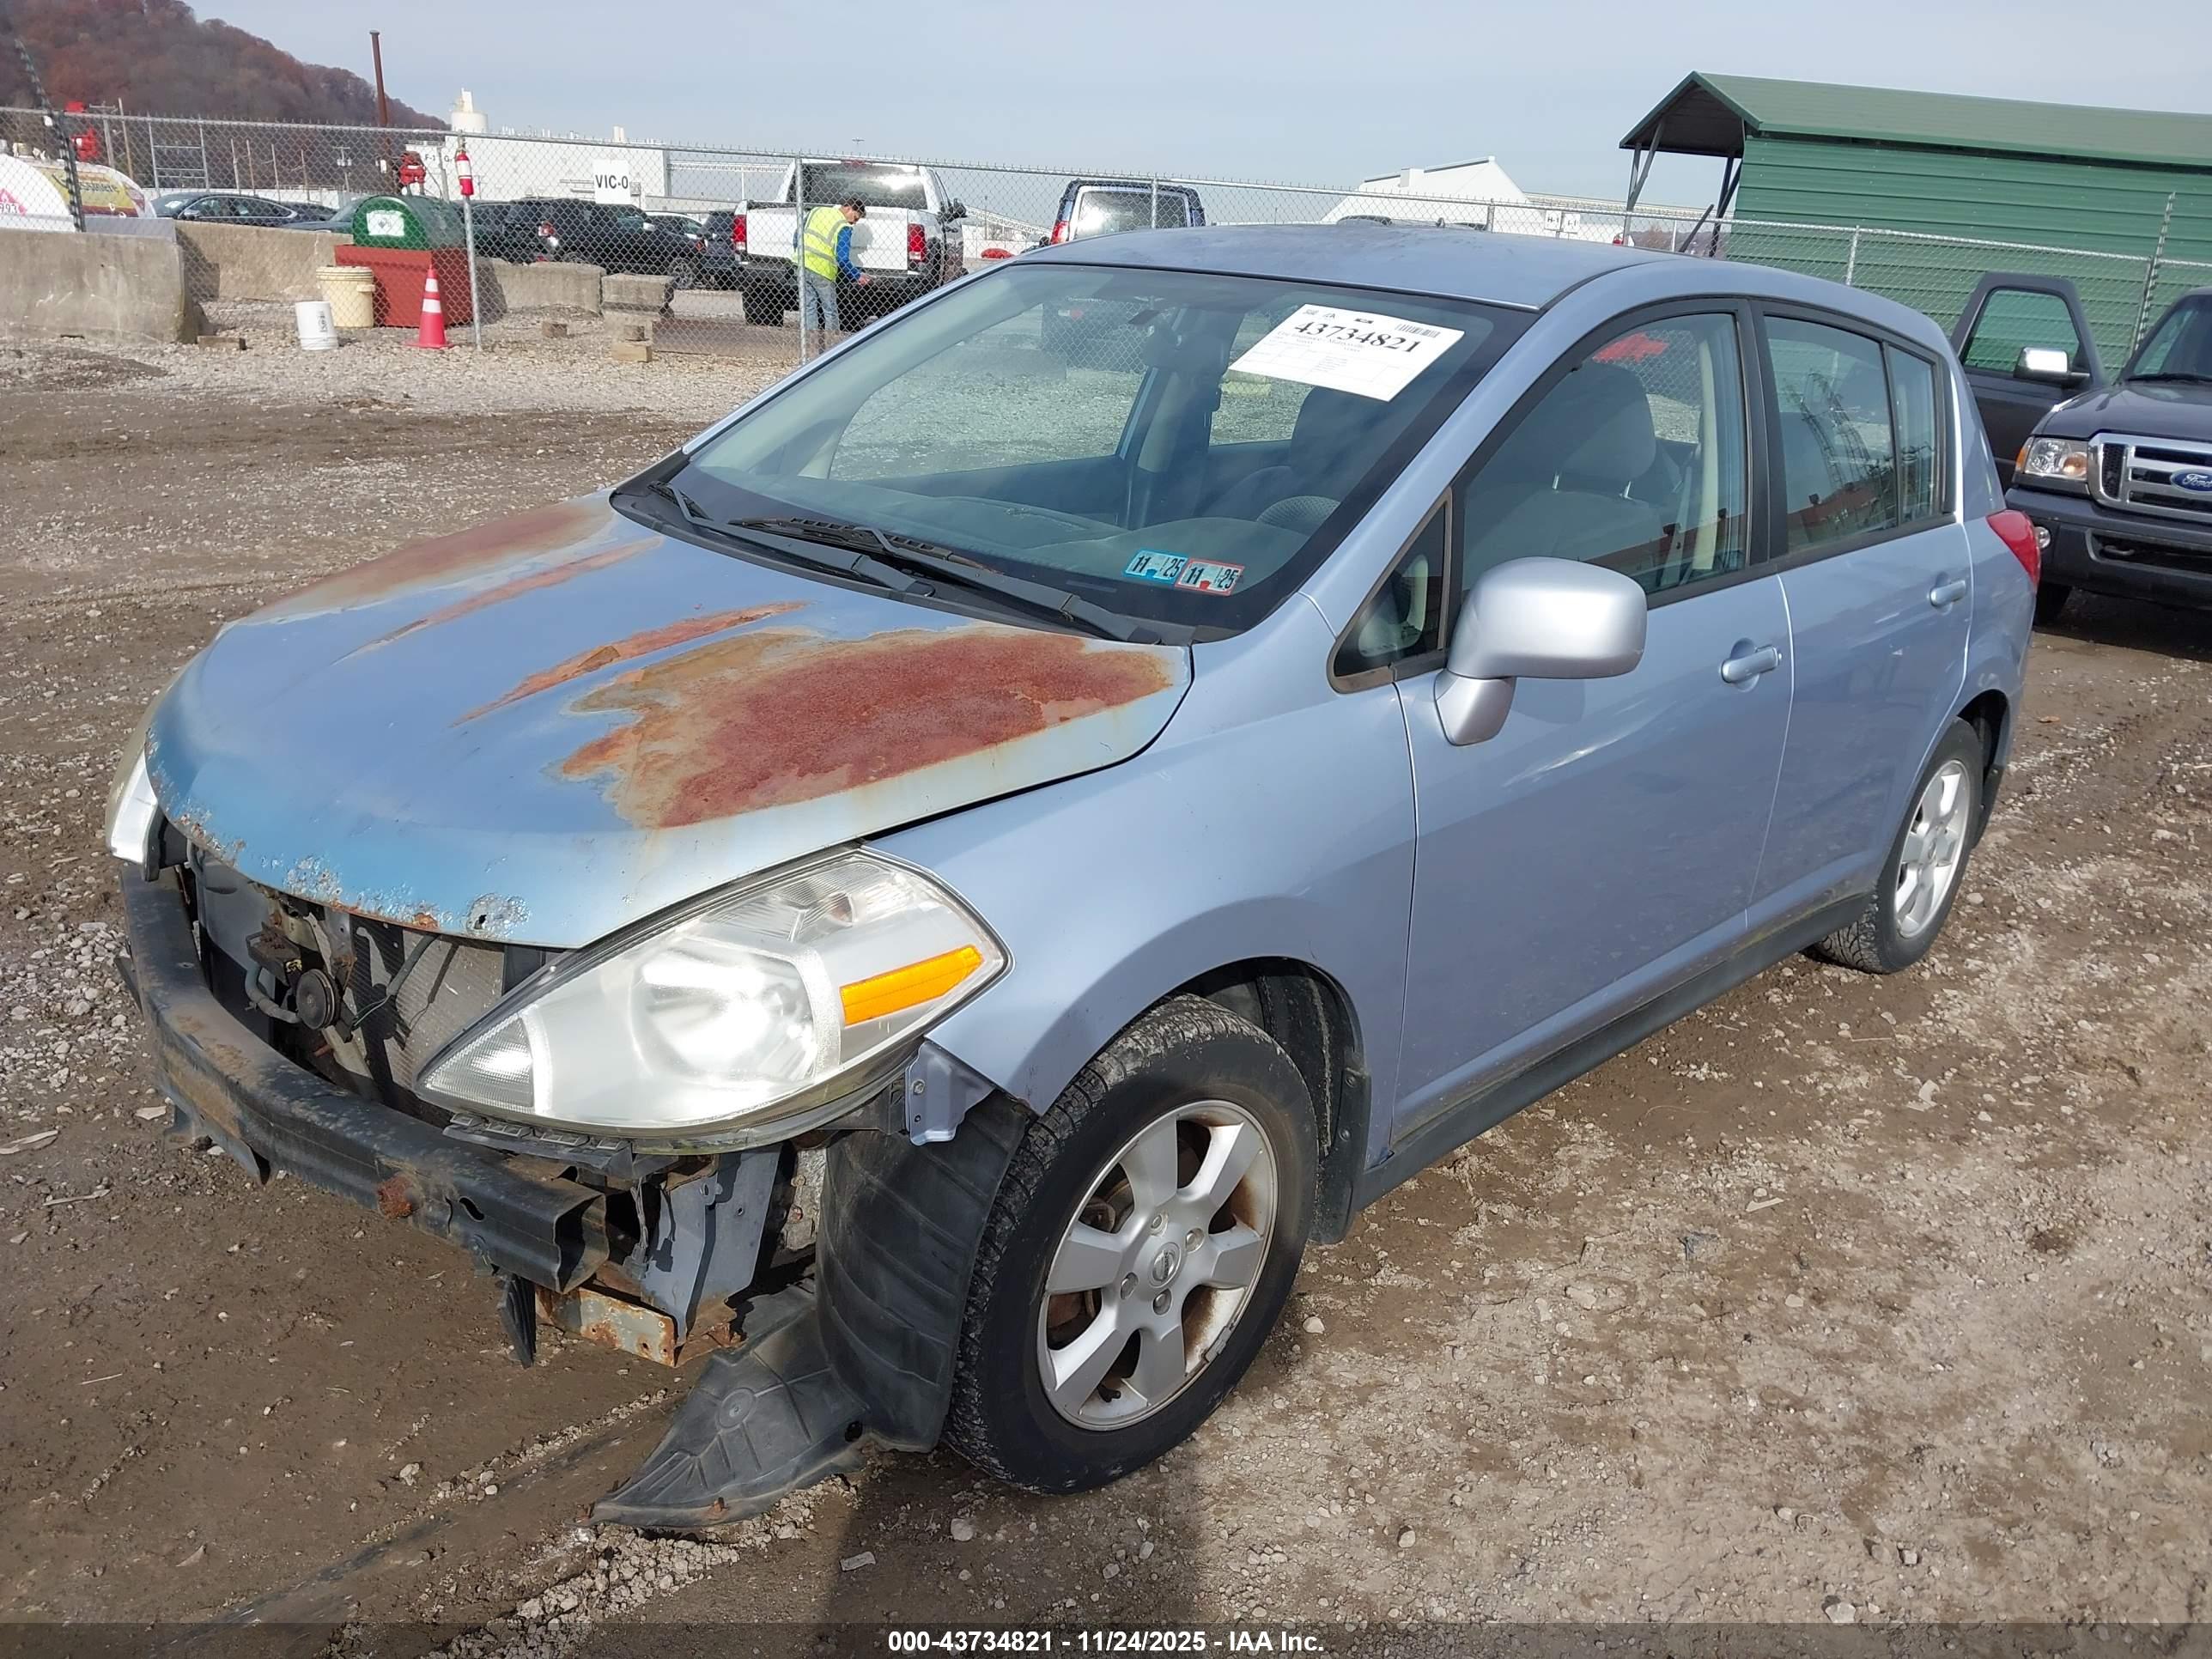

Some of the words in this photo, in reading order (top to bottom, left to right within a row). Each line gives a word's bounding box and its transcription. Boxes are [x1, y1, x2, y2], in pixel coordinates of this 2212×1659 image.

[1294, 321, 1421, 353] 43734821
[1133, 556, 1152, 573] 11
[1163, 557, 1185, 578] 25
[1186, 567, 1205, 585] 11
[1218, 568, 1239, 589] 25
